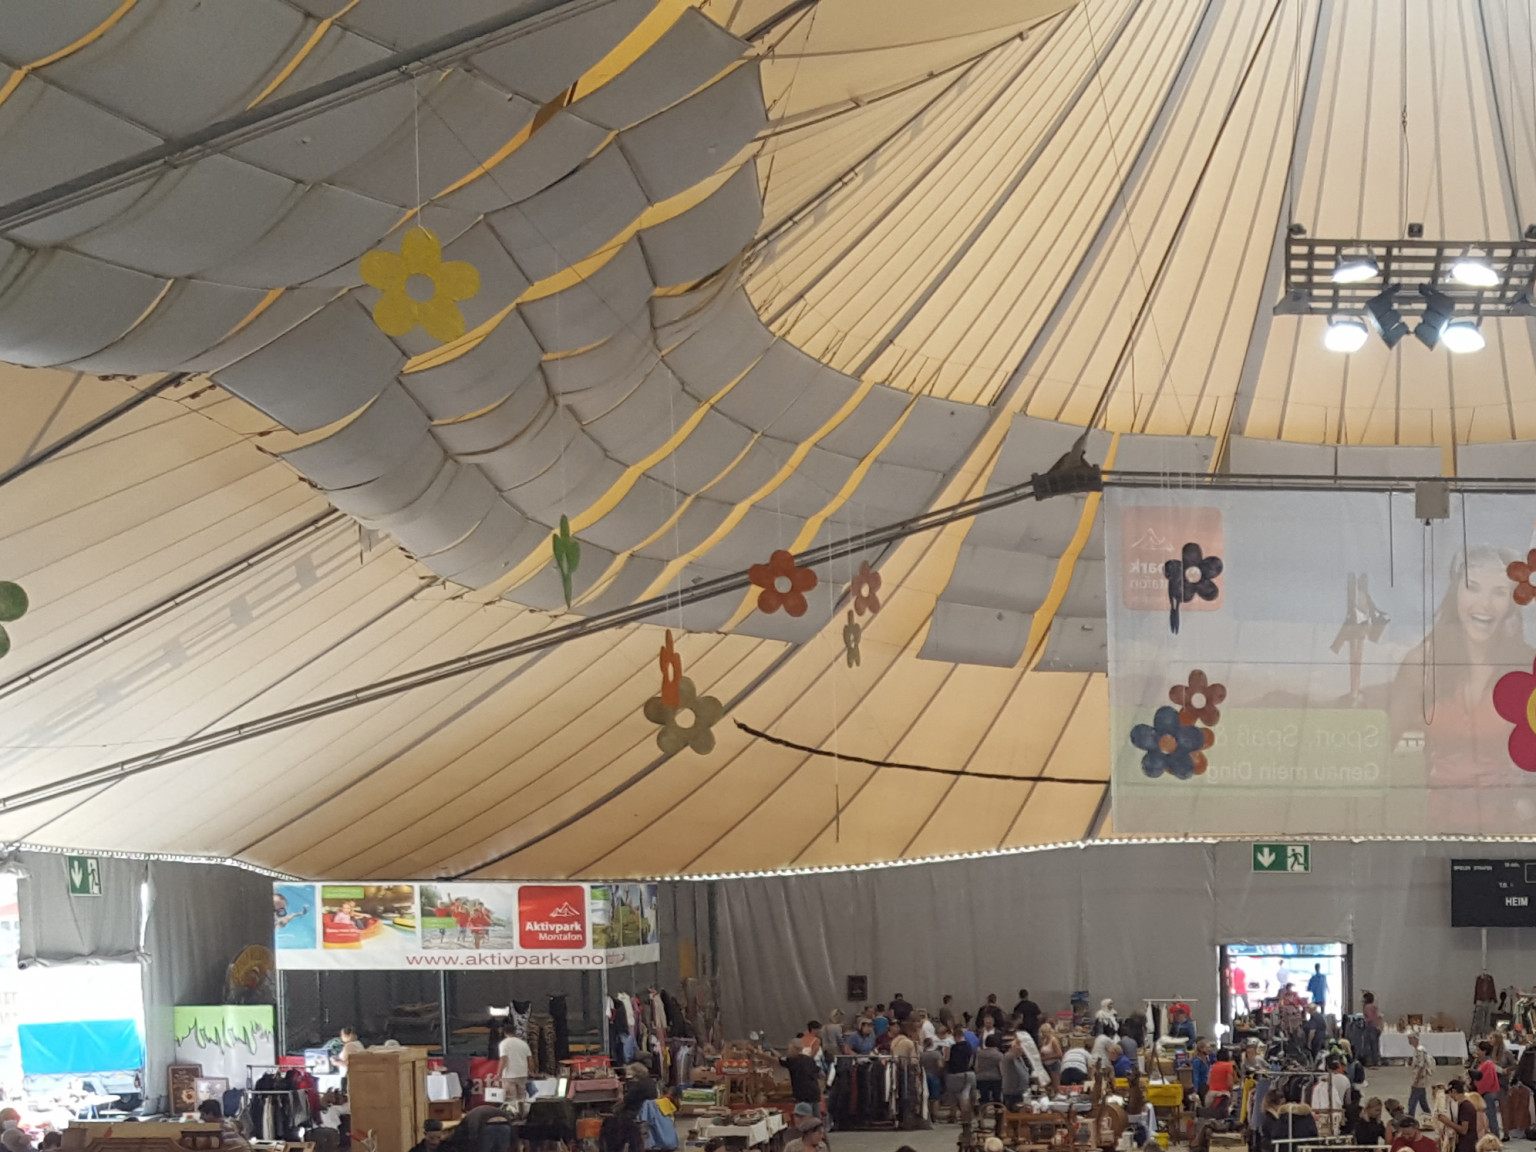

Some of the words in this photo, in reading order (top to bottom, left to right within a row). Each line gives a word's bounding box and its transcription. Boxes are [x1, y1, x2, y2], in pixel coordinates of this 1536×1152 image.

[1505, 896, 1529, 907] HEIM
[525, 921, 582, 933] Aktivpark
[538, 932, 583, 941] Montafon
[406, 952, 625, 967] www.aktivpark-mo
